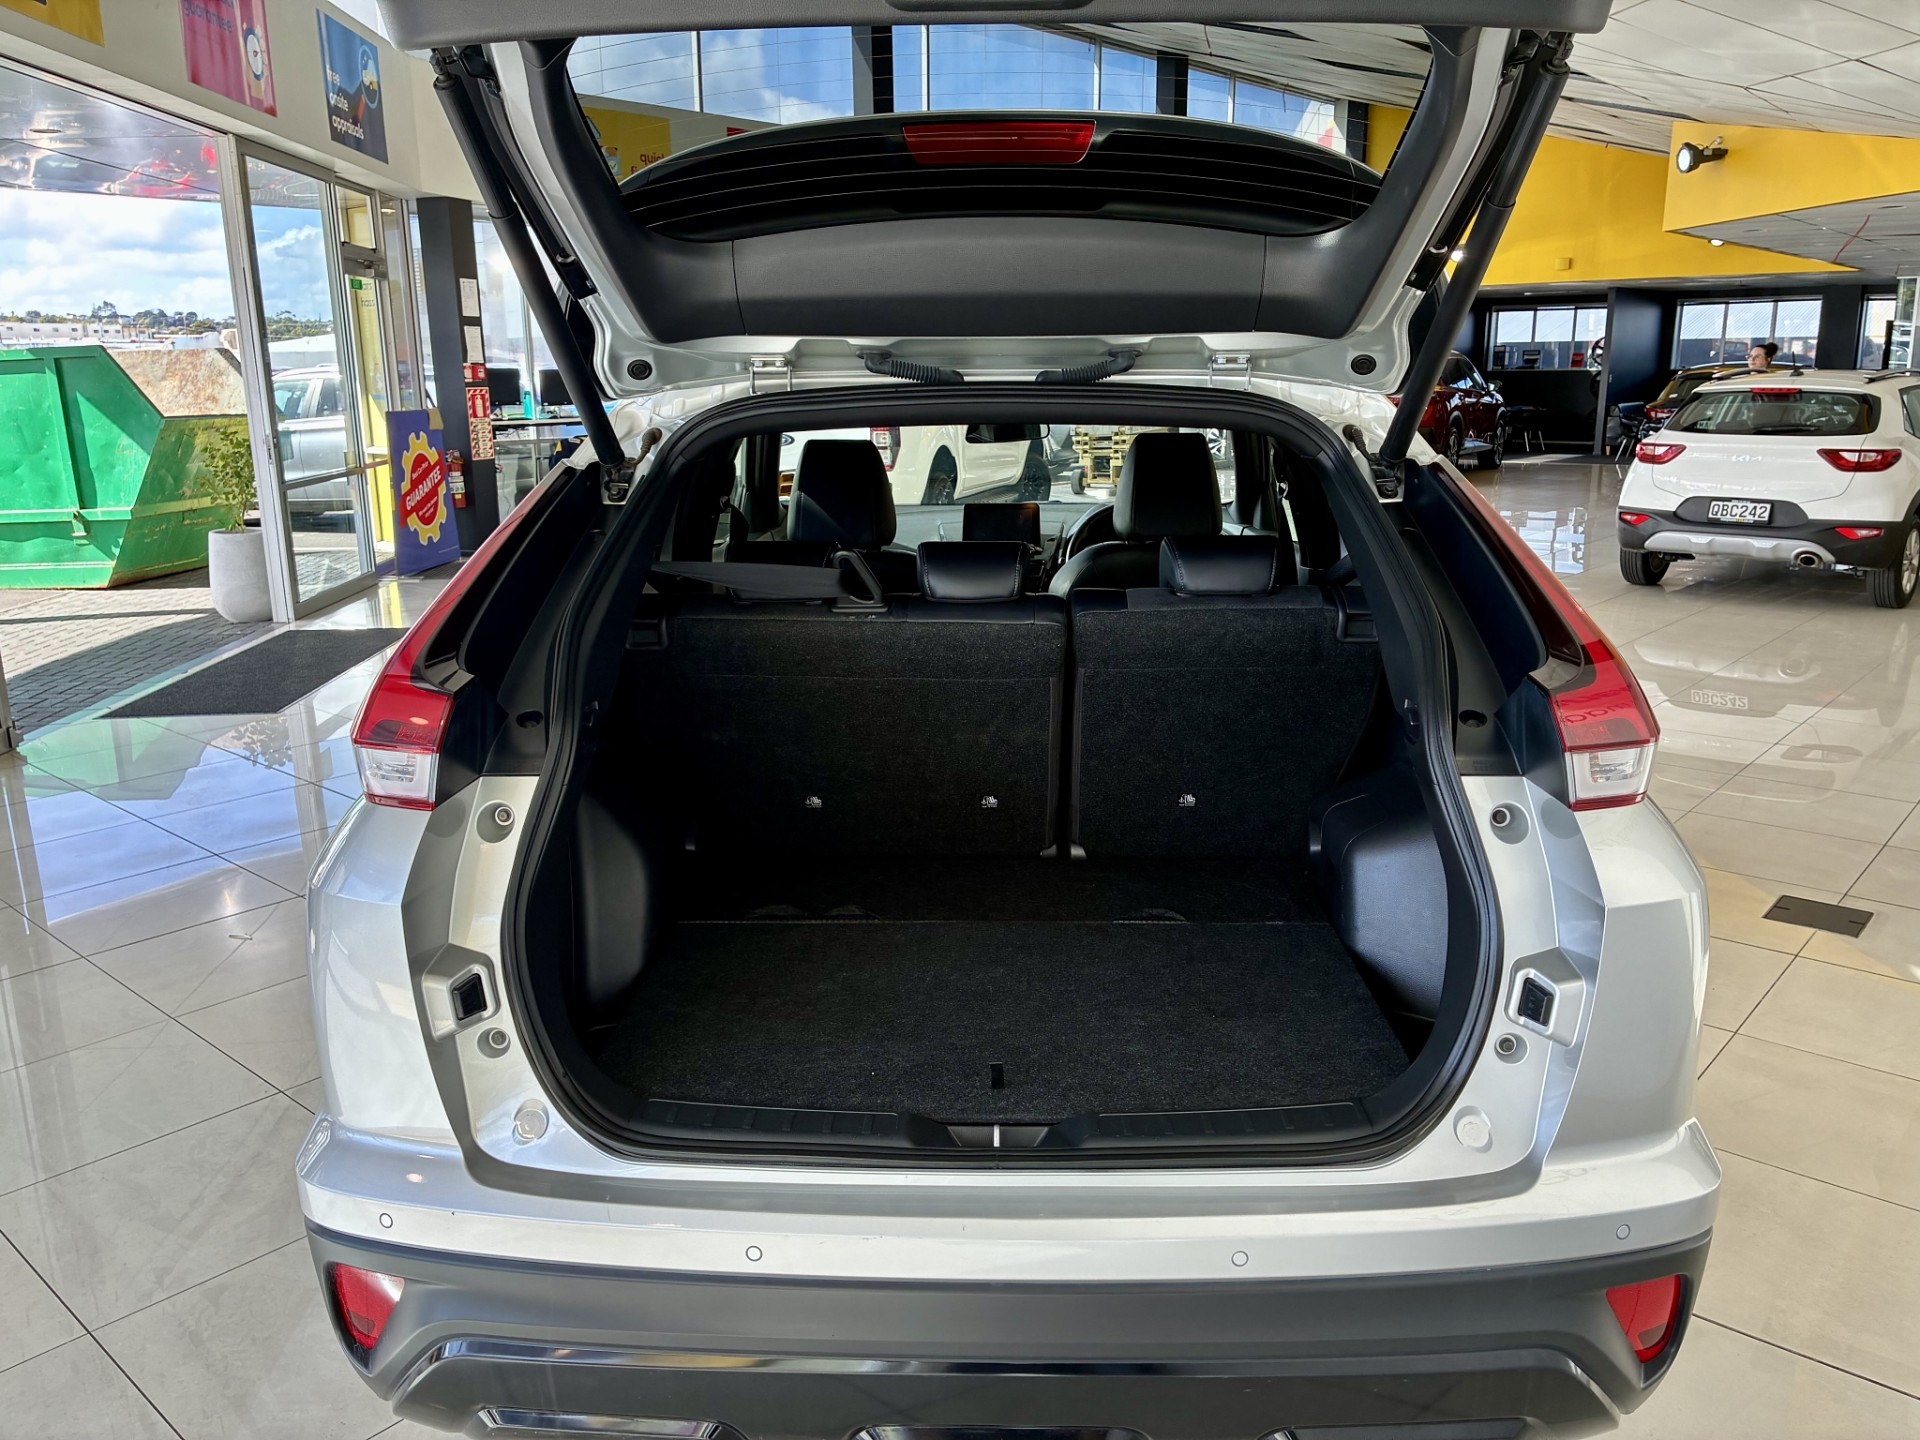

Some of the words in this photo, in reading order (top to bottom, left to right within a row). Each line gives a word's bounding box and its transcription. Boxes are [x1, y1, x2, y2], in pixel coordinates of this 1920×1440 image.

[326, 64, 340, 86] free
[329, 92, 349, 112] onsite
[332, 115, 365, 140] appraisals
[640, 152, 665, 166] quic
[406, 465, 442, 510] GUARANTEE
[1711, 503, 1768, 519] QBC242
